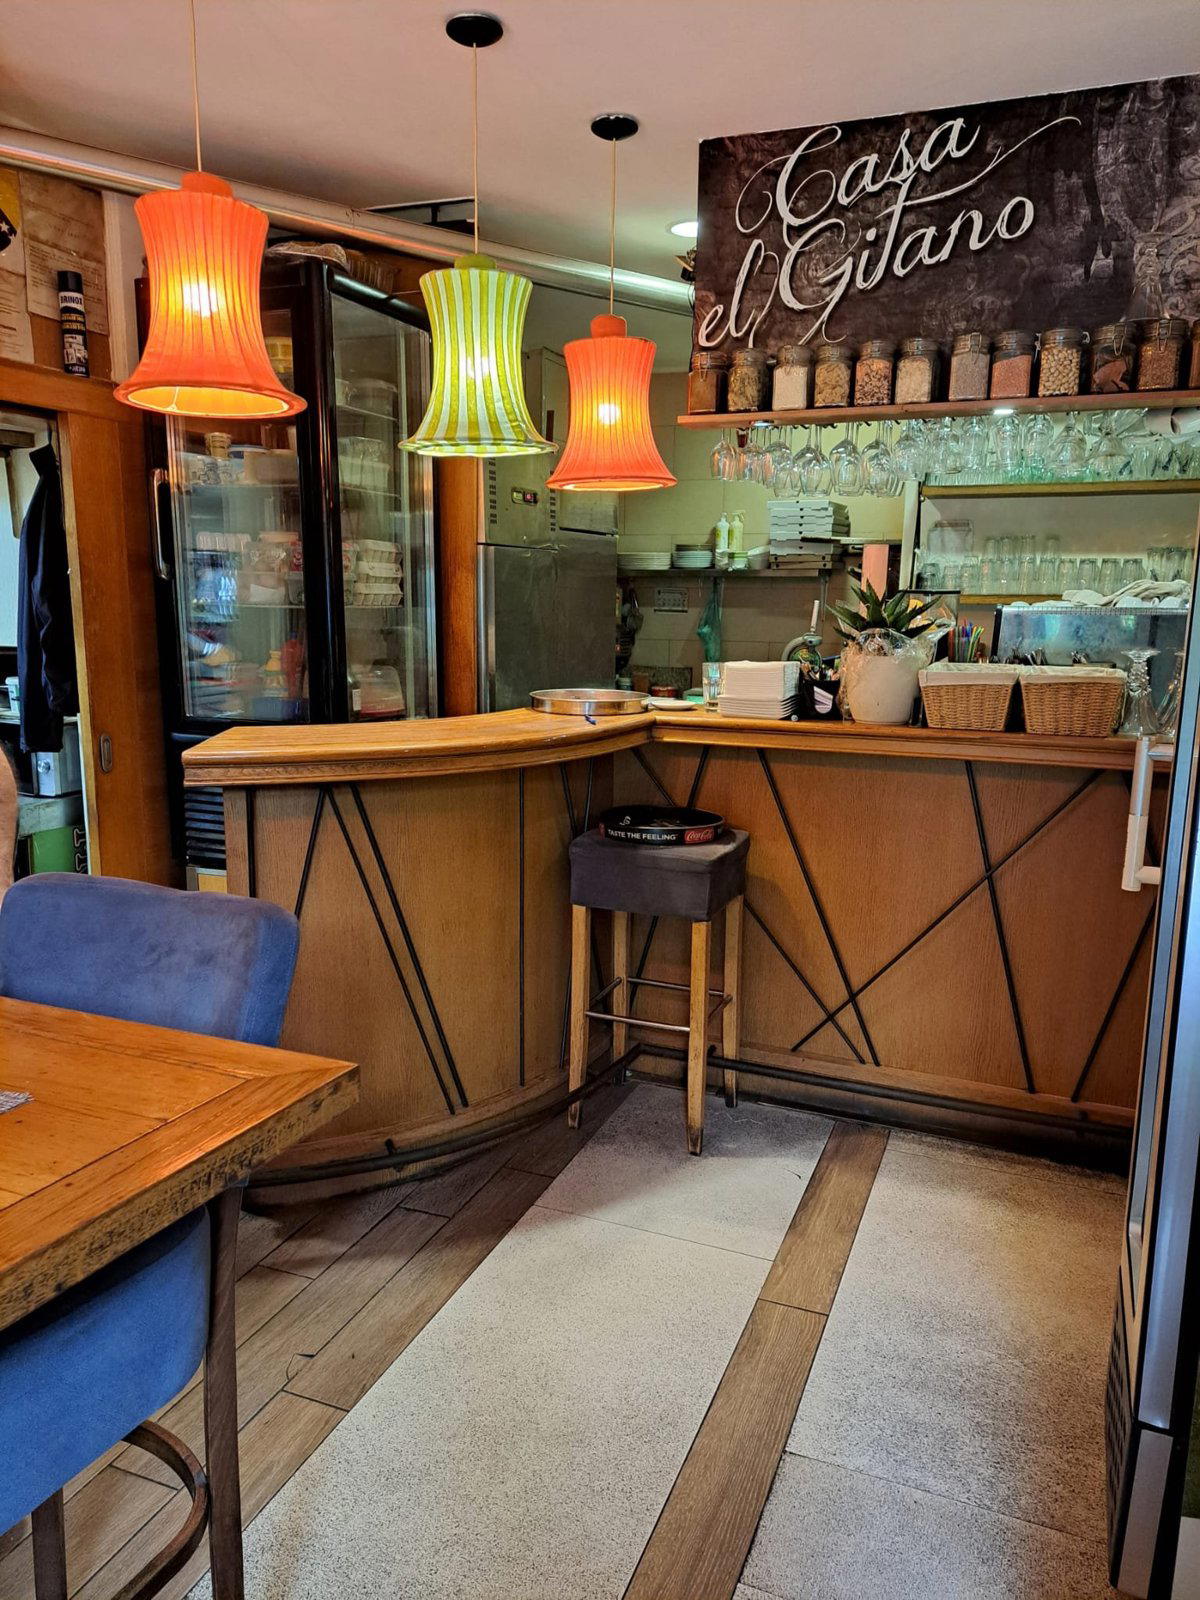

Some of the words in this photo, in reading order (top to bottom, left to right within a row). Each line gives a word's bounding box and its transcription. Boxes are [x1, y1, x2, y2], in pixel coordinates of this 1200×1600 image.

[698, 239, 774, 347] el
[779, 117, 1081, 344] Gitano
[736, 117, 981, 233] Casa
[608, 829, 626, 838] TASTE
[627, 832, 641, 840] THE
[642, 833, 677, 841] FEELING
